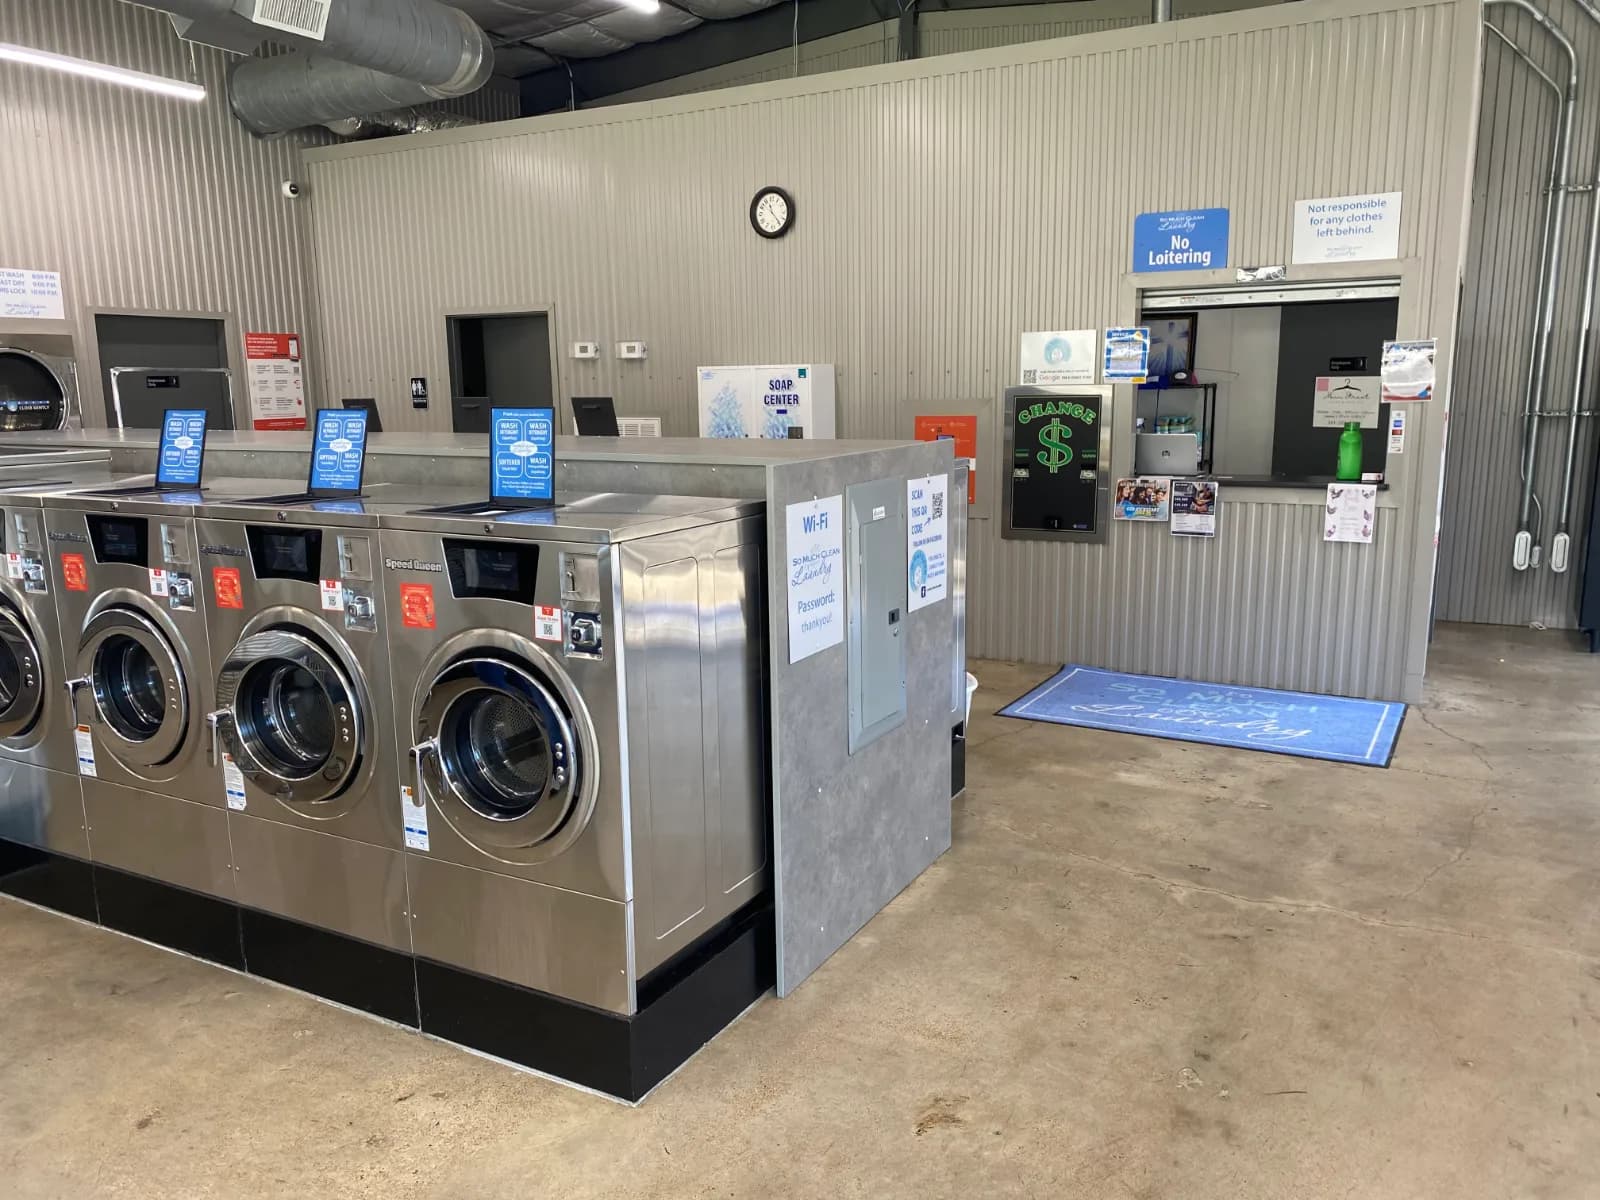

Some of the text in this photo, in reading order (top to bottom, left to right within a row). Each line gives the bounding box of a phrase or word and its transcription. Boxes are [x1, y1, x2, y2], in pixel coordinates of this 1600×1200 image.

[1307, 199, 1387, 213] Not responsible
[1310, 212, 1383, 226] for any clothes
[1316, 225, 1374, 237] left behind.
[1171, 234, 1190, 250] No
[1148, 249, 1212, 267] Loitering
[769, 379, 794, 391] SOAP
[763, 394, 800, 405] CENTER
[1018, 401, 1097, 425] CHANGE
[529, 457, 547, 465] WASH
[911, 489, 923, 500] SCAN
[911, 506, 921, 517] THIS
[802, 511, 829, 535] Wi-Fi
[911, 523, 923, 535] CODE
[802, 554, 820, 564] MUCH
[820, 547, 841, 559] CLEAN
[385, 557, 443, 572] Speed Queen
[791, 561, 832, 587] Laundry
[797, 590, 836, 615] Password:
[1106, 682, 1318, 713] SO MUCH
[1128, 694, 1280, 718] CLEAN
[1070, 703, 1313, 741] Laundry
